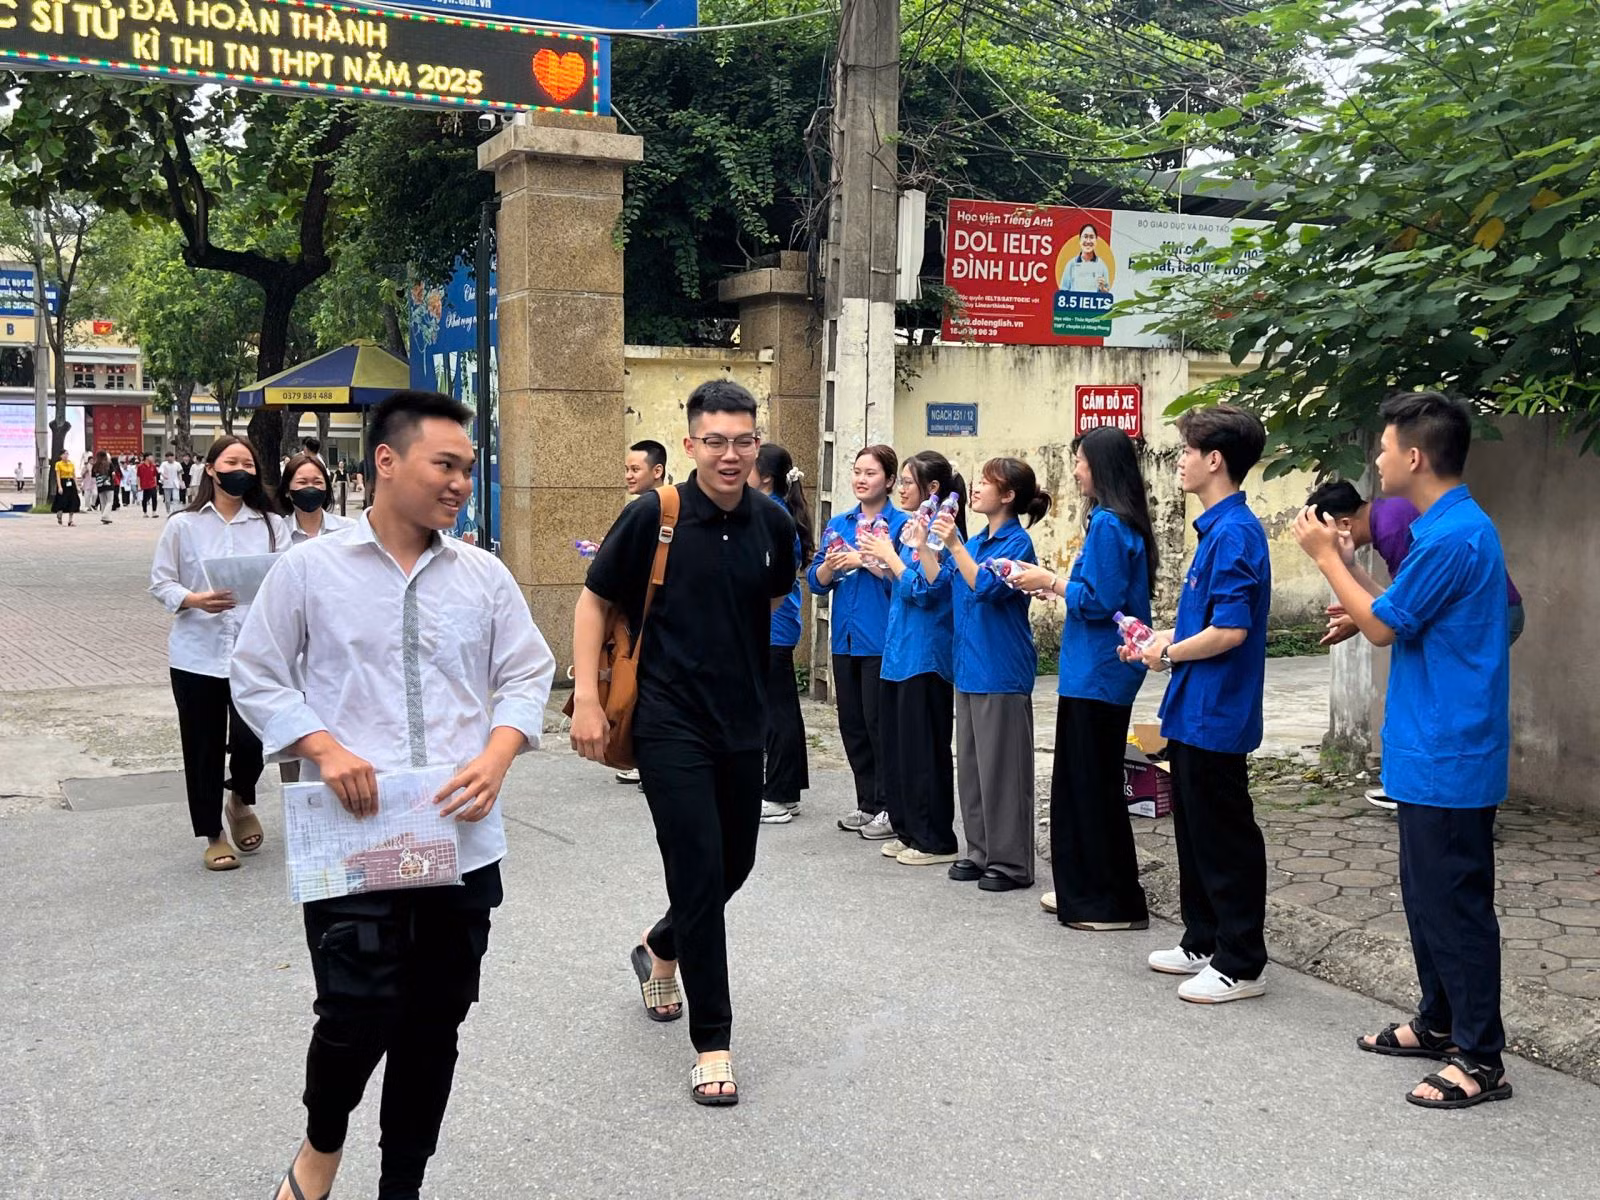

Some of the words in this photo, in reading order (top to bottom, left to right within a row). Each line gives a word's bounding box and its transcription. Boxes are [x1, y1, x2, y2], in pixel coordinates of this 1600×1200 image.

[72, 0, 125, 40] TỬ
[186, 0, 280, 37] HOÀN
[289, 10, 387, 49] THÀNH
[132, 27, 160, 61] KÌ
[170, 36, 214, 67] THI
[224, 43, 260, 72] TN
[269, 47, 335, 80] THPT
[343, 51, 412, 88] NĂM
[417, 63, 484, 95] 2025
[957, 210, 977, 224] Học
[1033, 216, 1054, 227] Anh
[954, 230, 998, 253] DOL
[1003, 232, 1053, 256] IELTS
[952, 253, 1003, 281] ĐÌNH
[1009, 260, 1048, 287] LỰC
[1058, 295, 1077, 308] 8.5
[1080, 297, 1112, 310] IELTS
[7, 323, 14, 335] B
[282, 392, 301, 400] 0379
[303, 392, 317, 400] 884
[318, 392, 333, 400] 488
[1082, 390, 1104, 410] CẤM
[1106, 390, 1119, 410] ĐỖ
[1122, 395, 1134, 410] XE
[1081, 413, 1098, 430] ÔTÔ
[1118, 412, 1136, 430] ĐÂY
